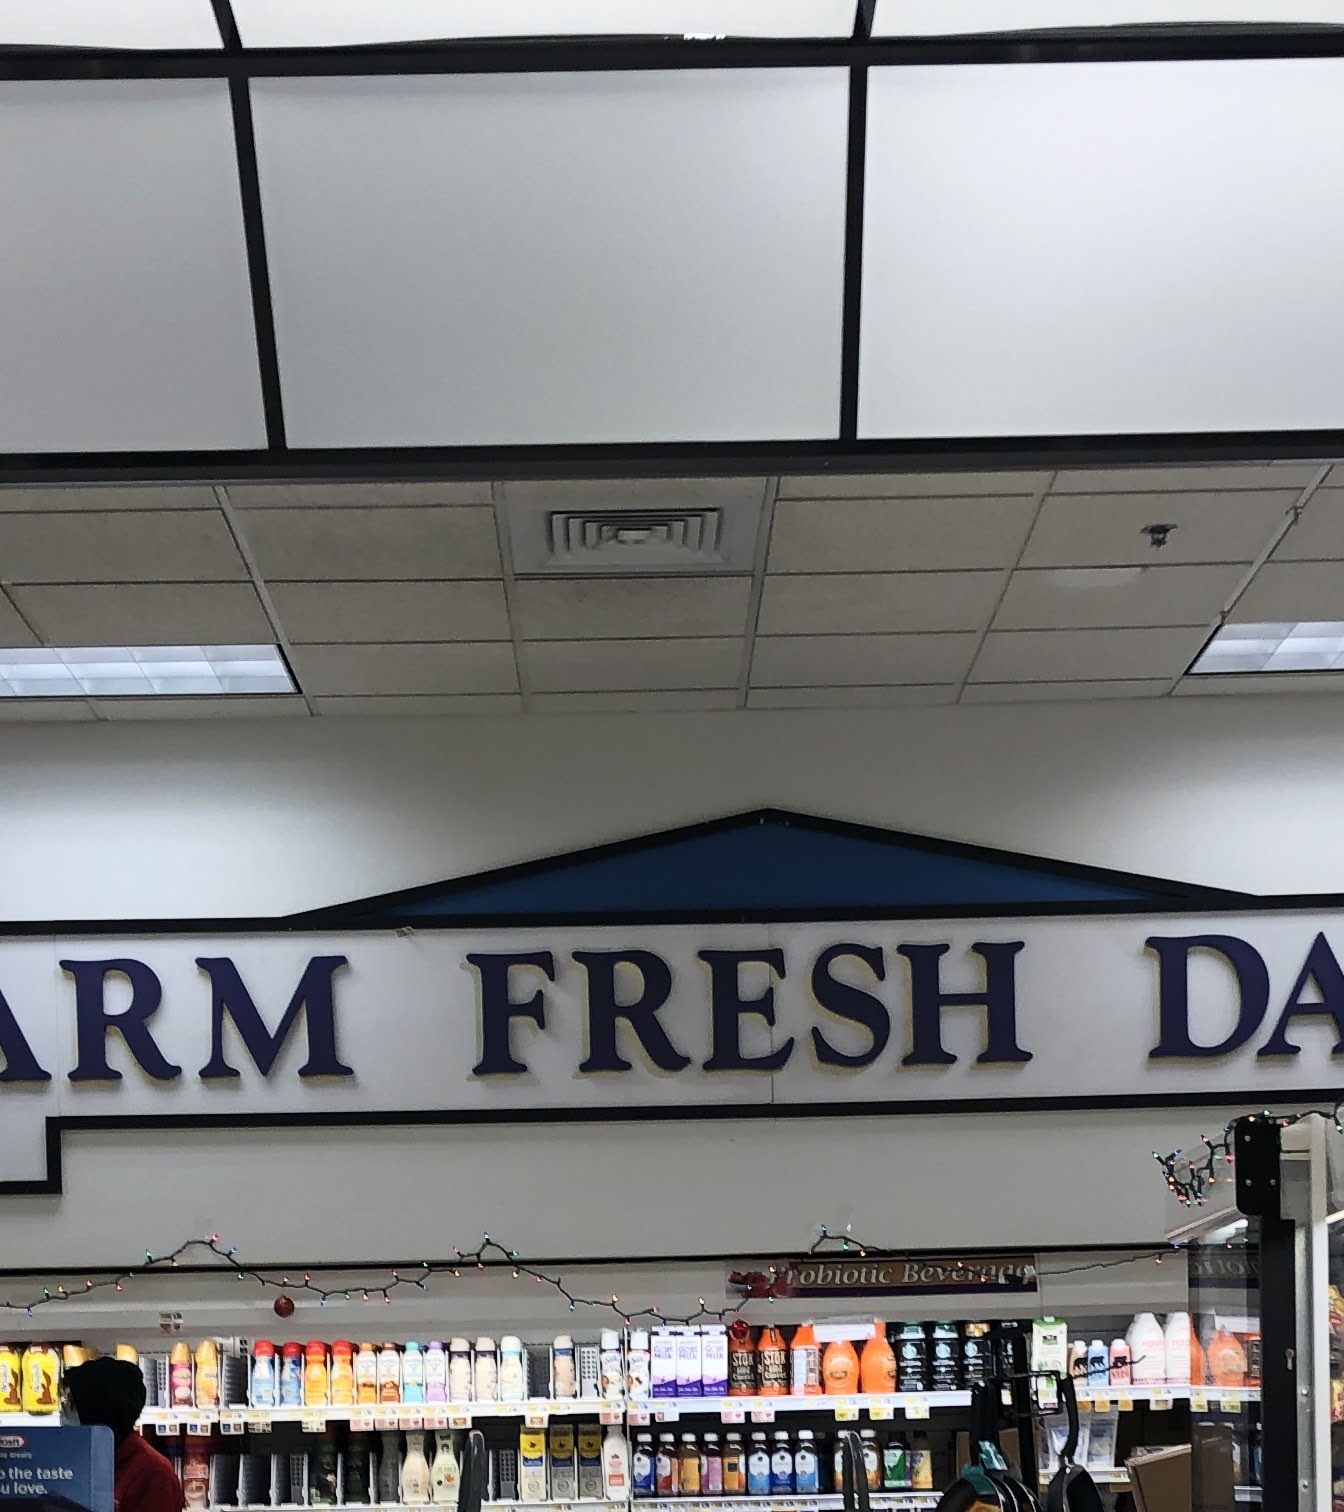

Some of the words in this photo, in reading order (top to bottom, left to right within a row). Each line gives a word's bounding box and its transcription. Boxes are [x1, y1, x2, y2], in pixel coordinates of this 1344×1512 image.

[466, 941, 1034, 1075] FRESH
[9, 1467, 33, 1480] the
[36, 1467, 73, 1480] taste
[14, 1482, 48, 1496] love.
